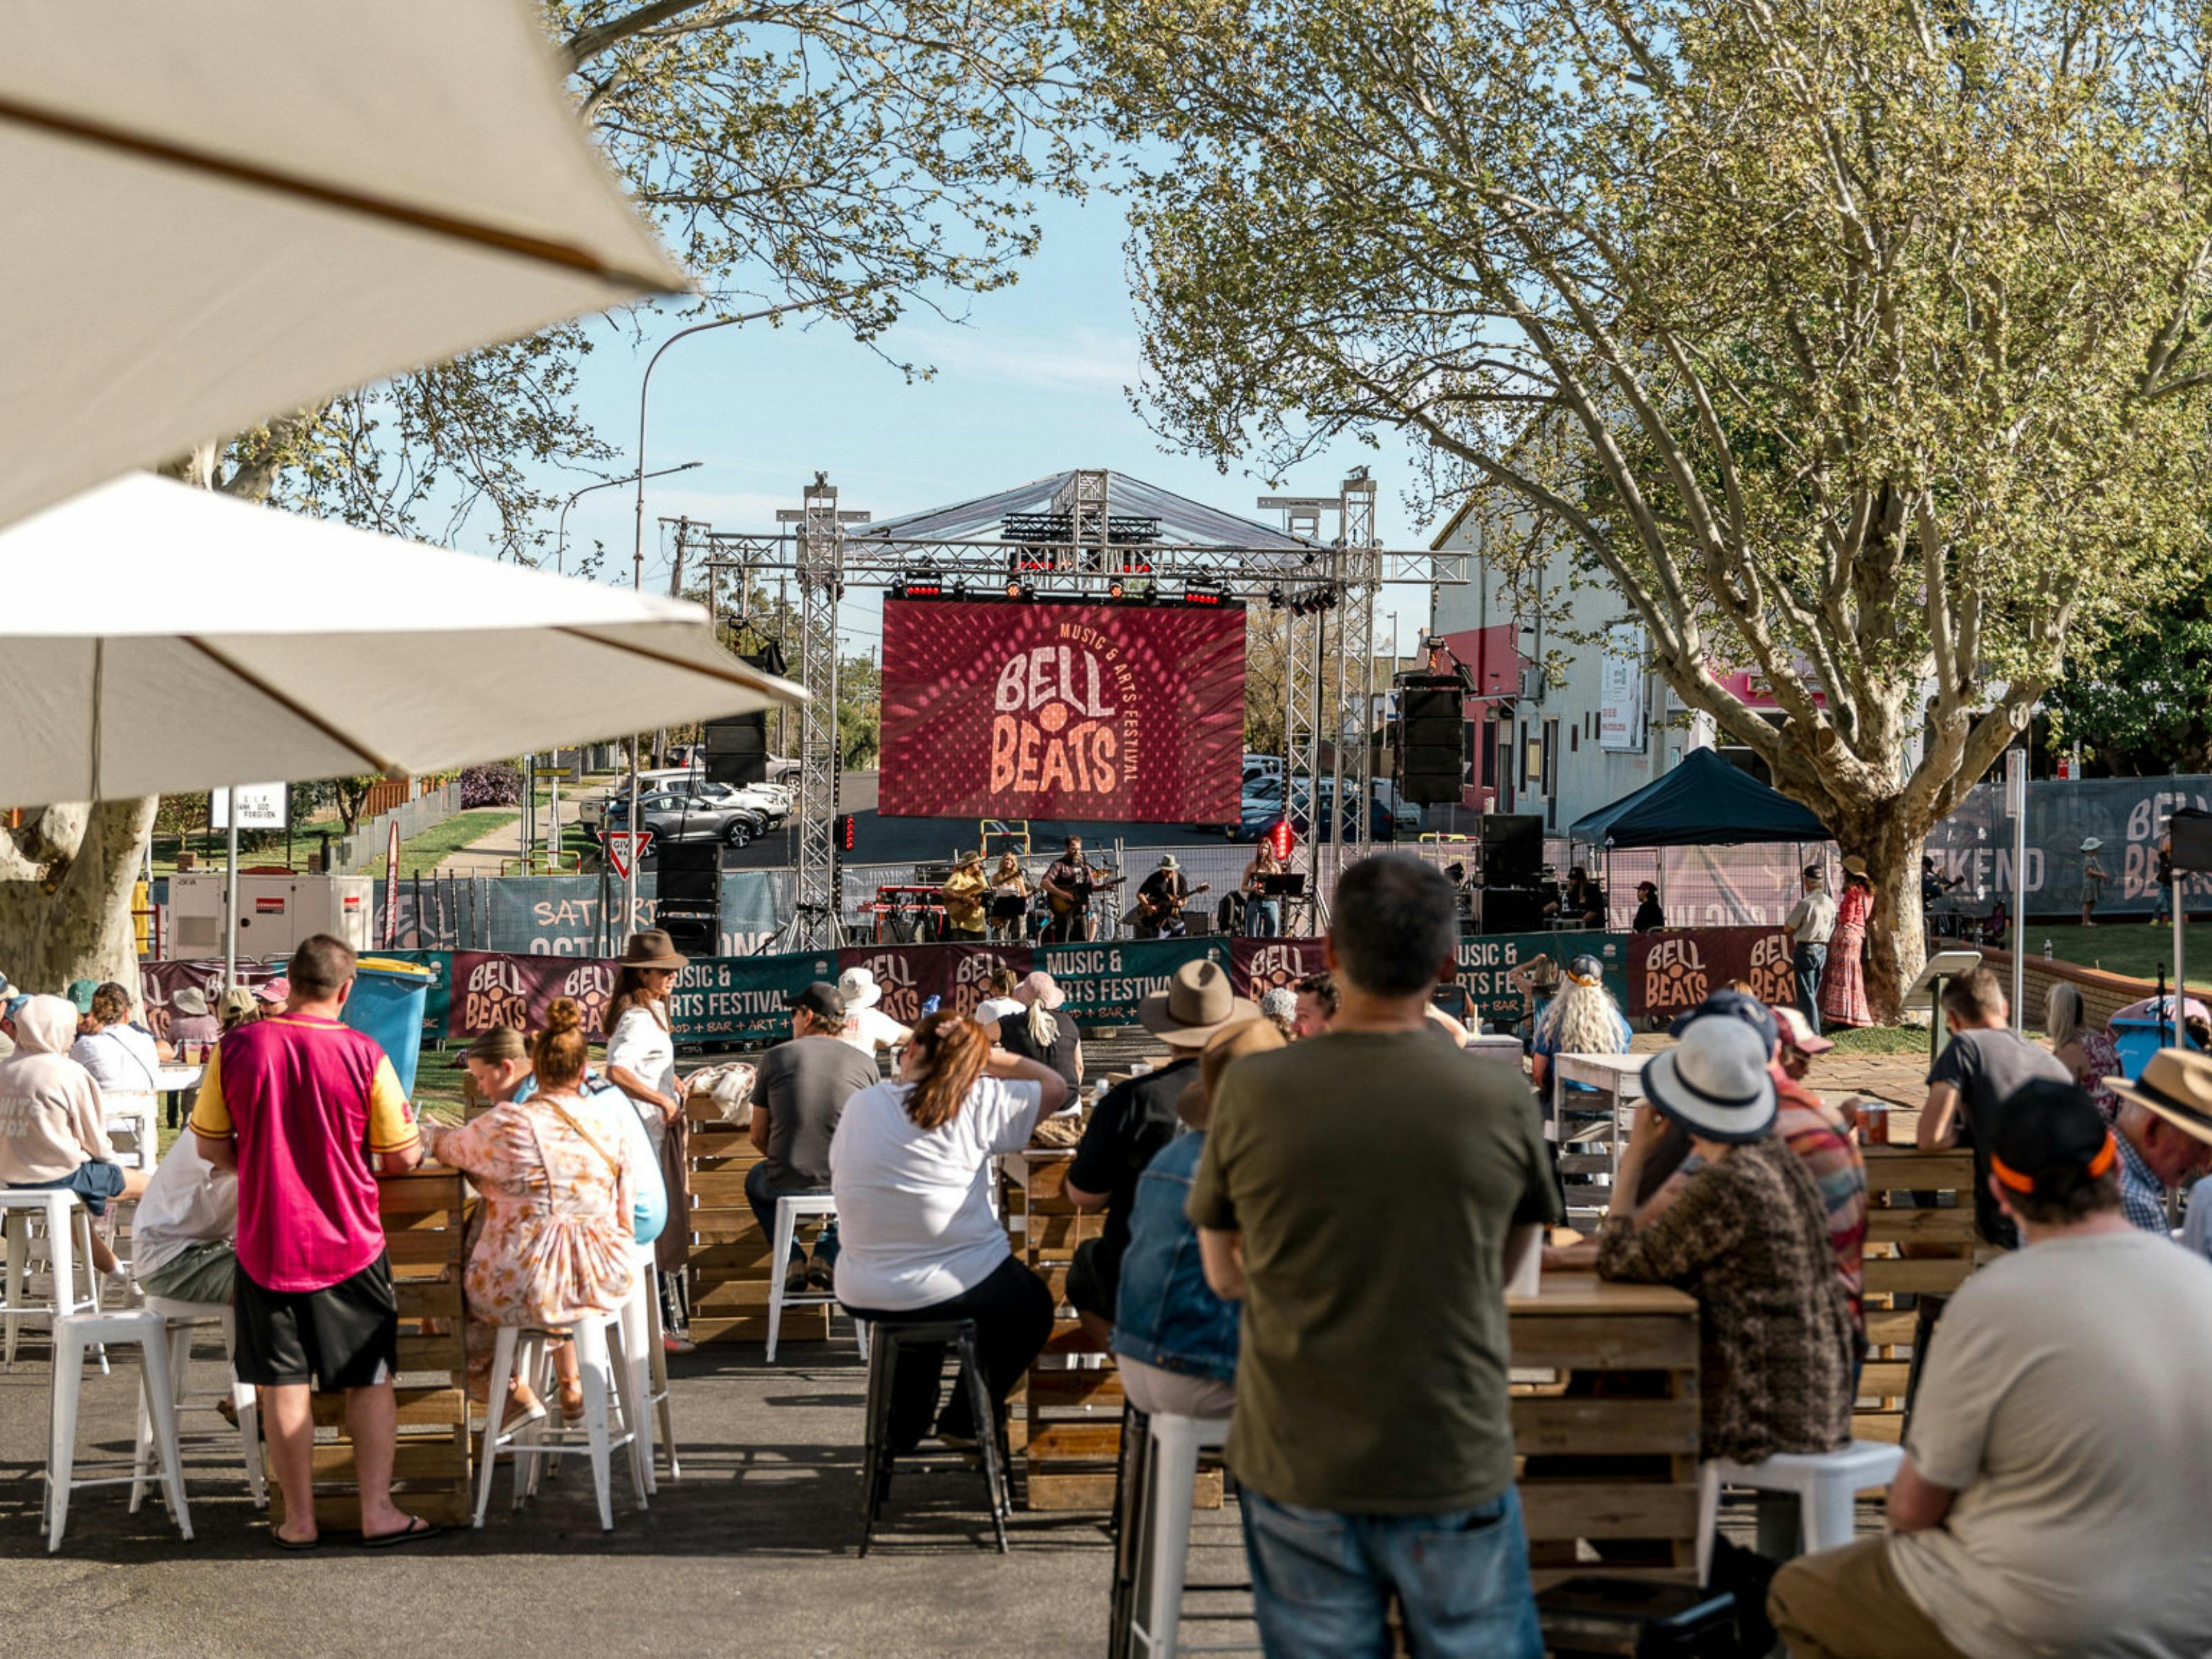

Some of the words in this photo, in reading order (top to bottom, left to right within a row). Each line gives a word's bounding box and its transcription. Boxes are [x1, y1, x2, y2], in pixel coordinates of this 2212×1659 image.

[1060, 623, 1106, 650] MUSIC
[1106, 648, 1119, 662] &
[995, 645, 1115, 718] BELL
[1114, 663, 1137, 704] ARTS
[991, 715, 1116, 795] BEATS
[1123, 710, 1138, 783] FESTIVAL
[614, 841, 629, 849] GIV
[1927, 847, 2045, 892] KEND
[1046, 950, 1105, 975] MUSIC
[1109, 949, 1123, 973] &
[1250, 945, 1310, 978] BELL
[1454, 943, 1499, 966] USIC
[1505, 942, 1517, 965] &
[1646, 939, 1705, 971] BELL
[1750, 935, 1794, 966] BEL
[468, 960, 526, 995] BELL
[673, 964, 713, 988] USIC
[718, 964, 731, 987] &
[1060, 979, 1096, 1003] RTS
[1100, 975, 1172, 1002] FESTIVA
[1456, 971, 1490, 995] RTS
[1646, 971, 1709, 1009] BEATS
[1750, 967, 1797, 1004] BEAT
[465, 993, 527, 1031] BEATS
[670, 993, 704, 1017] RTS
[883, 987, 919, 1021] ATS
[1098, 1006, 1126, 1019] BAR
[706, 1020, 734, 1033] BAR
[748, 1018, 778, 1031] ART
